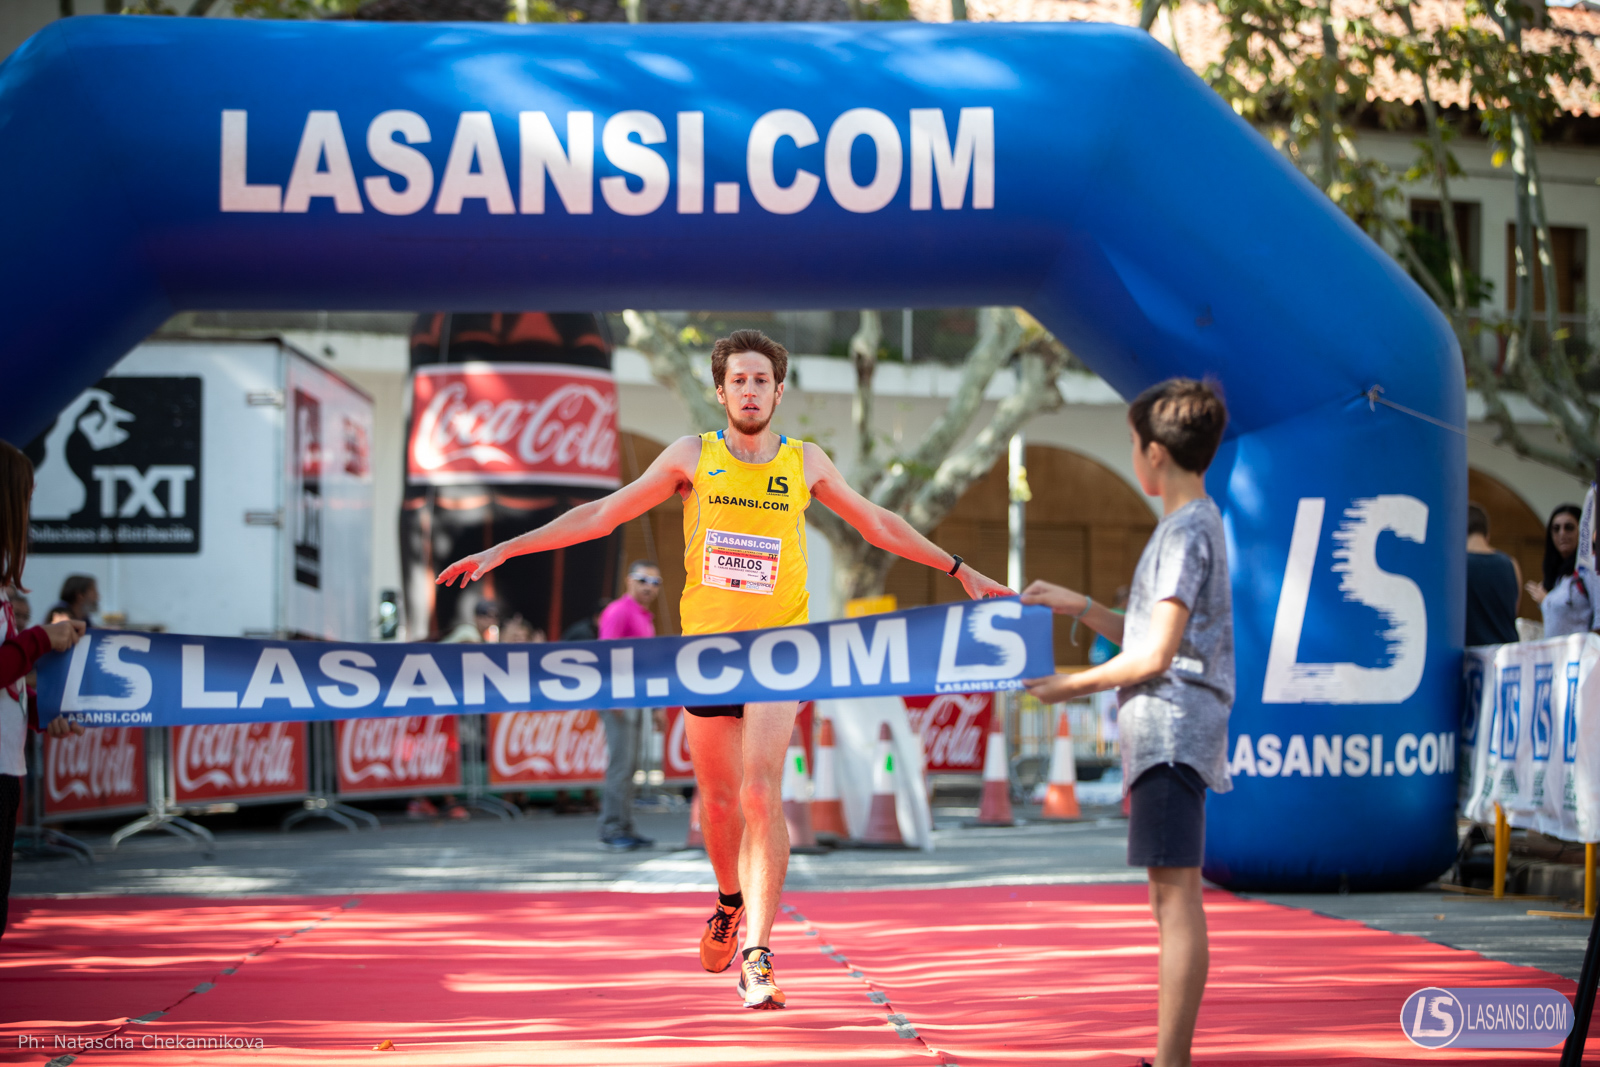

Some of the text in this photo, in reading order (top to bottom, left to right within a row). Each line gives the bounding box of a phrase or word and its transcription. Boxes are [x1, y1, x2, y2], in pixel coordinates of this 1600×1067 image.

[220, 107, 996, 215] LASANSI.COM
[413, 381, 617, 472] Coca-Cola
[92, 465, 195, 518] TXT
[708, 495, 789, 512] LASANSI.COM
[717, 536, 779, 551] LASANSI.COM
[717, 555, 763, 571] CARLOS
[1263, 494, 1429, 704] LS
[180, 617, 911, 709] LASANSI.COM
[61, 712, 153, 723] ASANSI.COM
[340, 715, 450, 784] CocaCola
[492, 709, 610, 776] CocaCola
[48, 727, 139, 803] CocaCola
[177, 721, 296, 793] CocaCola
[1228, 733, 1456, 777] ASANSI.COM
